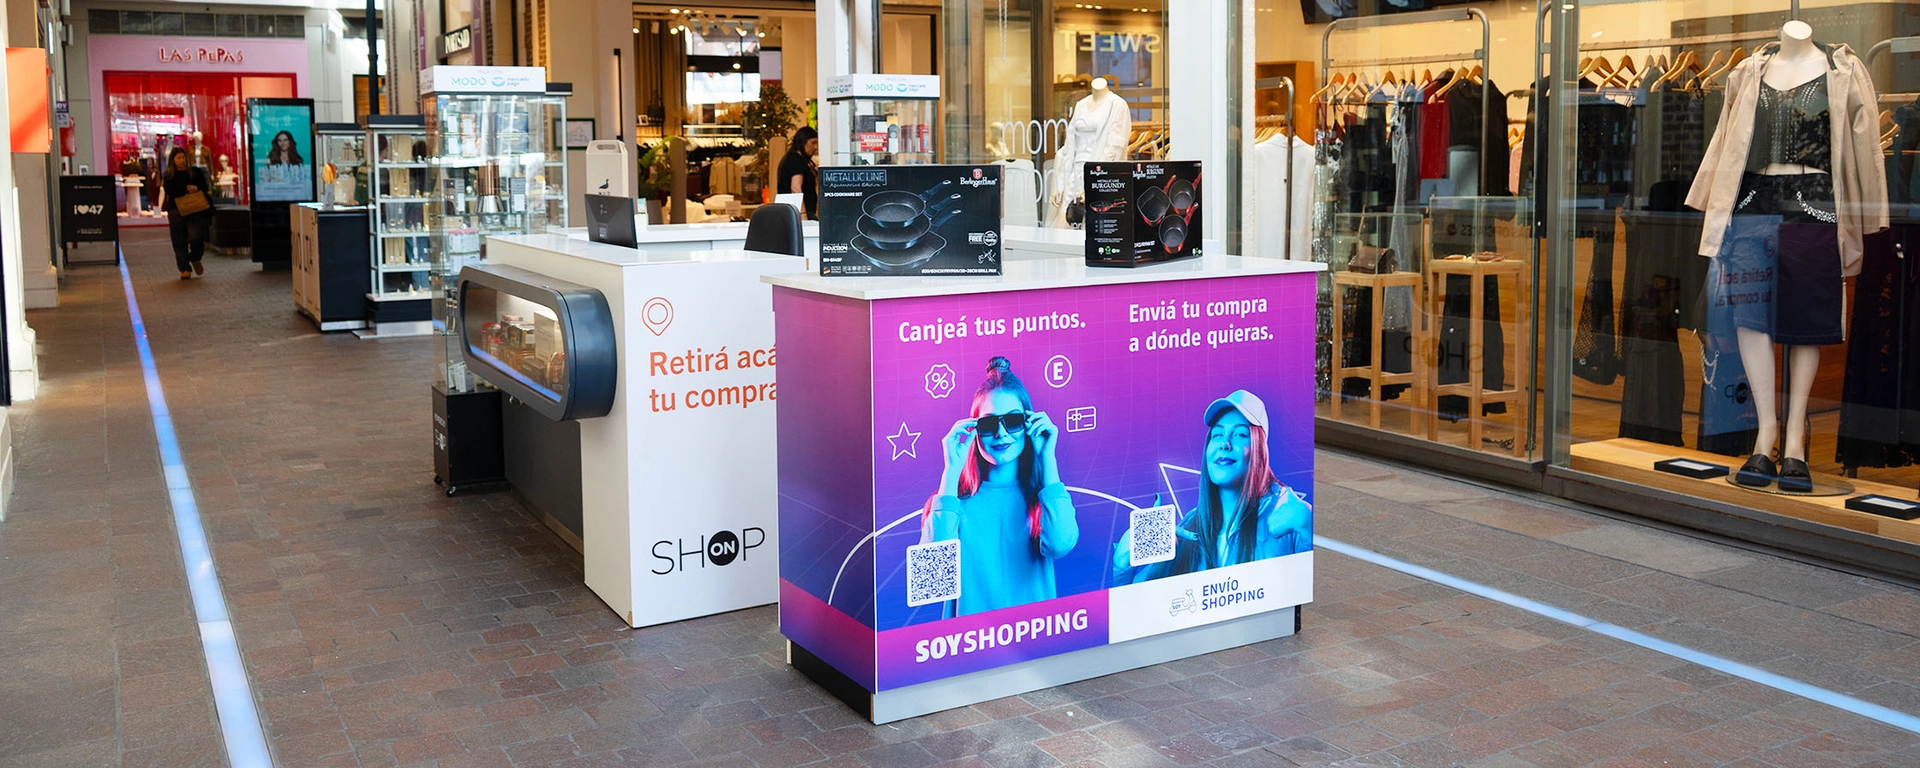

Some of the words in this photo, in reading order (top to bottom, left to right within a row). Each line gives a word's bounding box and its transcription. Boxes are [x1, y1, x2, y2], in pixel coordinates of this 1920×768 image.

[159, 48, 192, 63] LAS
[451, 77, 487, 86] MODO
[866, 83, 893, 91] MODO
[825, 172, 865, 182] METALLIC
[866, 172, 885, 182] LINE
[1129, 299, 1176, 323] Enviá
[1182, 300, 1200, 319] tu
[1206, 298, 1267, 319] compra
[899, 315, 968, 345] Canjeá
[974, 316, 1006, 336] tus
[1013, 311, 1086, 338] puntos.
[1129, 336, 1139, 352] a
[1145, 328, 1201, 351] dónde
[1207, 323, 1274, 349] quieras.
[649, 346, 729, 377] Retirá
[737, 343, 777, 369] acá
[1053, 361, 1064, 381] E
[649, 388, 676, 413] tu
[710, 540, 736, 557] ON
[1202, 576, 1239, 597] ENVÍO
[1202, 588, 1265, 611] SHOPPING
